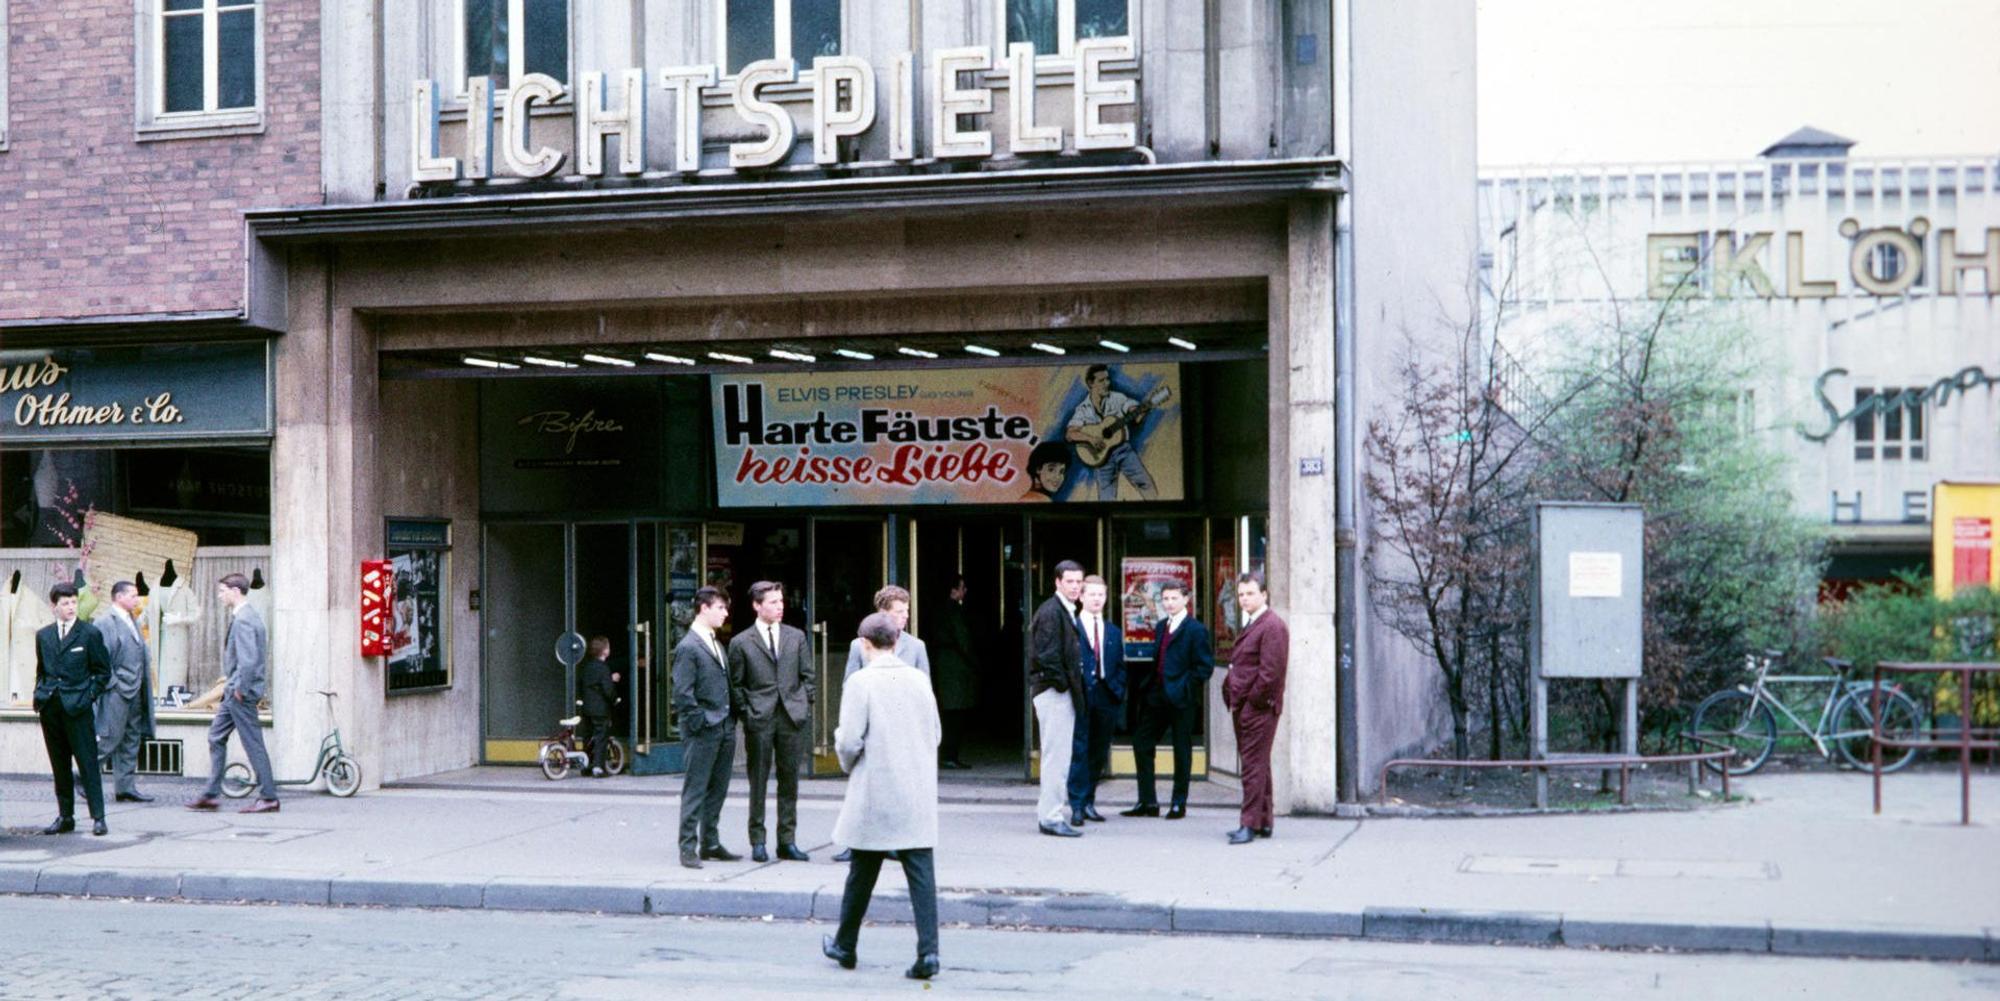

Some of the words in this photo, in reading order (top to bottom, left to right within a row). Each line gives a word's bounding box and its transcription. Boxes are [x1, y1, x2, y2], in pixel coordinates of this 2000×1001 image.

[412, 36, 1138, 181] LICHTSPIELE
[14, 391, 125, 427] Othmer
[144, 391, 184, 424] Co.
[722, 383, 857, 446] Harte
[861, 407, 1040, 446] Fäuste,
[777, 386, 831, 403] ELVIS
[834, 384, 919, 402] PRESLEY
[735, 446, 873, 485] heisse
[876, 444, 1017, 486] Liebe
